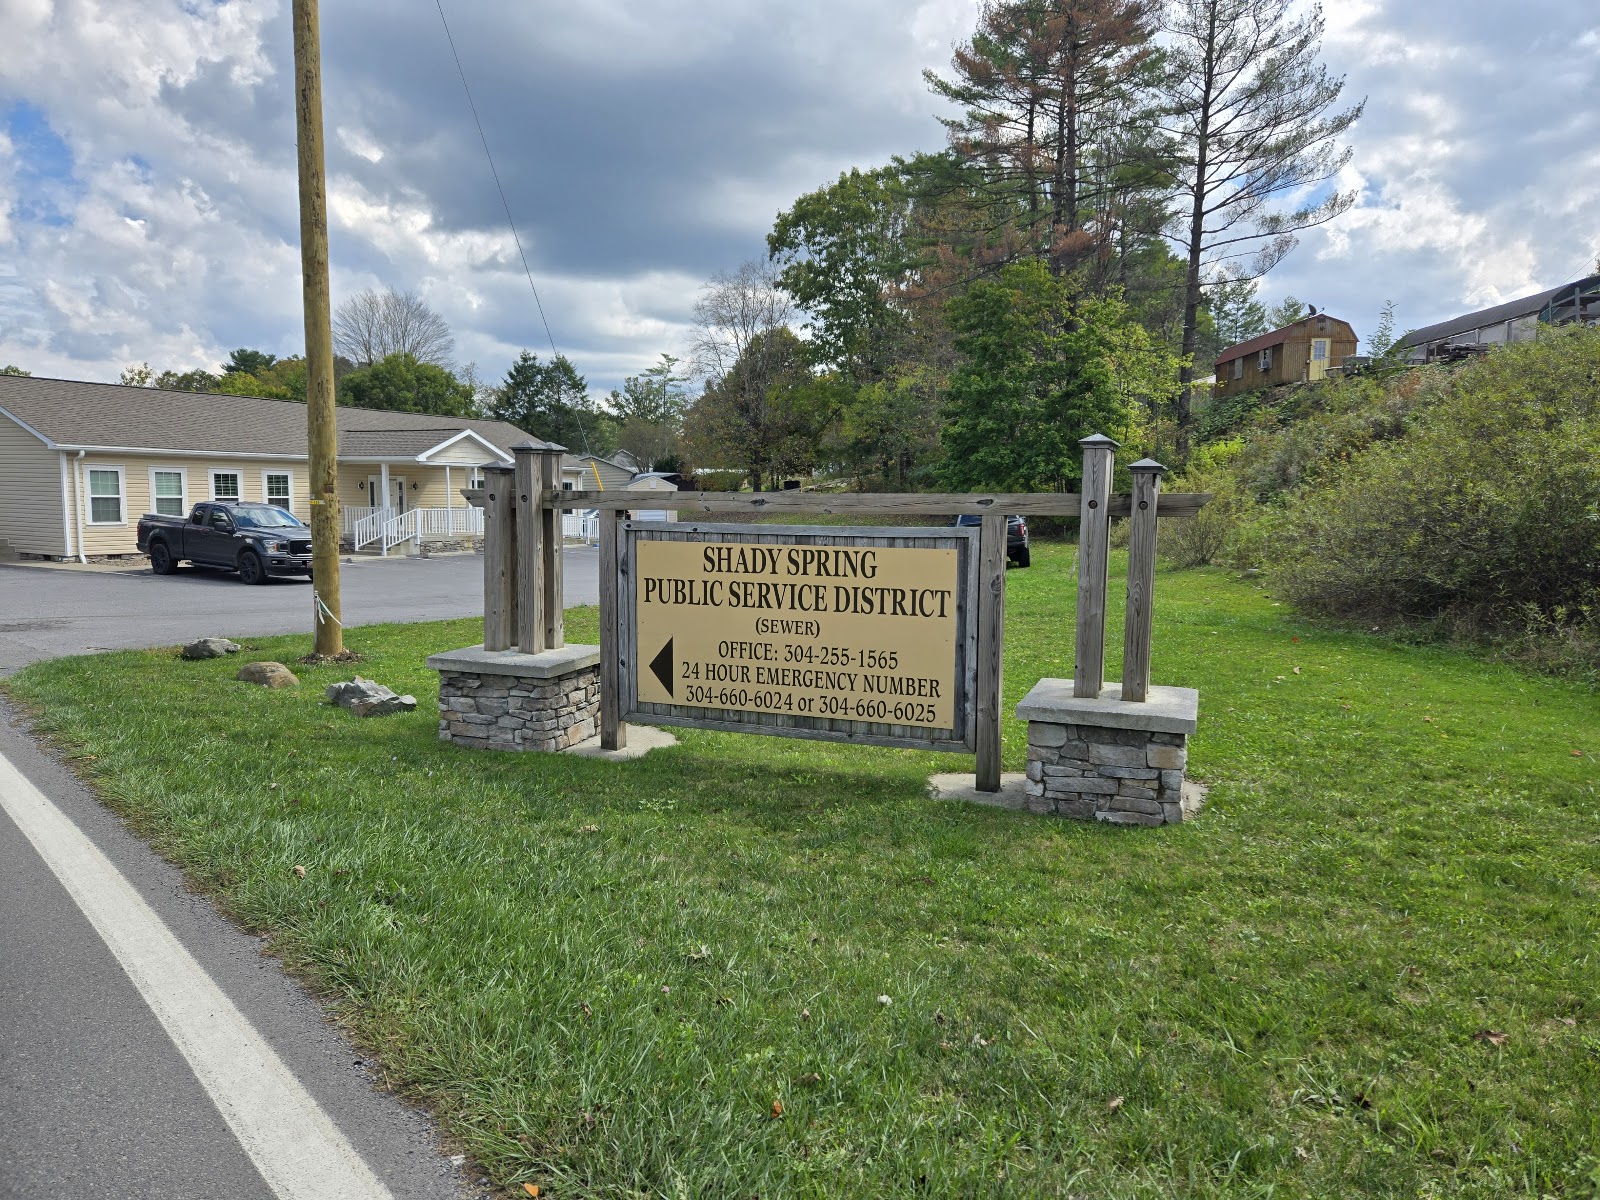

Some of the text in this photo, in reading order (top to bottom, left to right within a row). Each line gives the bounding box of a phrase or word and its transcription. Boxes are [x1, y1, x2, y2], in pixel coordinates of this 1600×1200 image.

[703, 546, 878, 579] SHADY SPRING
[643, 577, 951, 618] PUBLIC SERVICE DISTRICT
[755, 616, 821, 639] (SEWER)
[718, 640, 898, 670] OFFICE: 304-255-1565
[682, 661, 941, 699] 24 HOUR EMERGENCY NUMBER
[686, 685, 936, 723] 304-660-6024 or 304-660-6025
